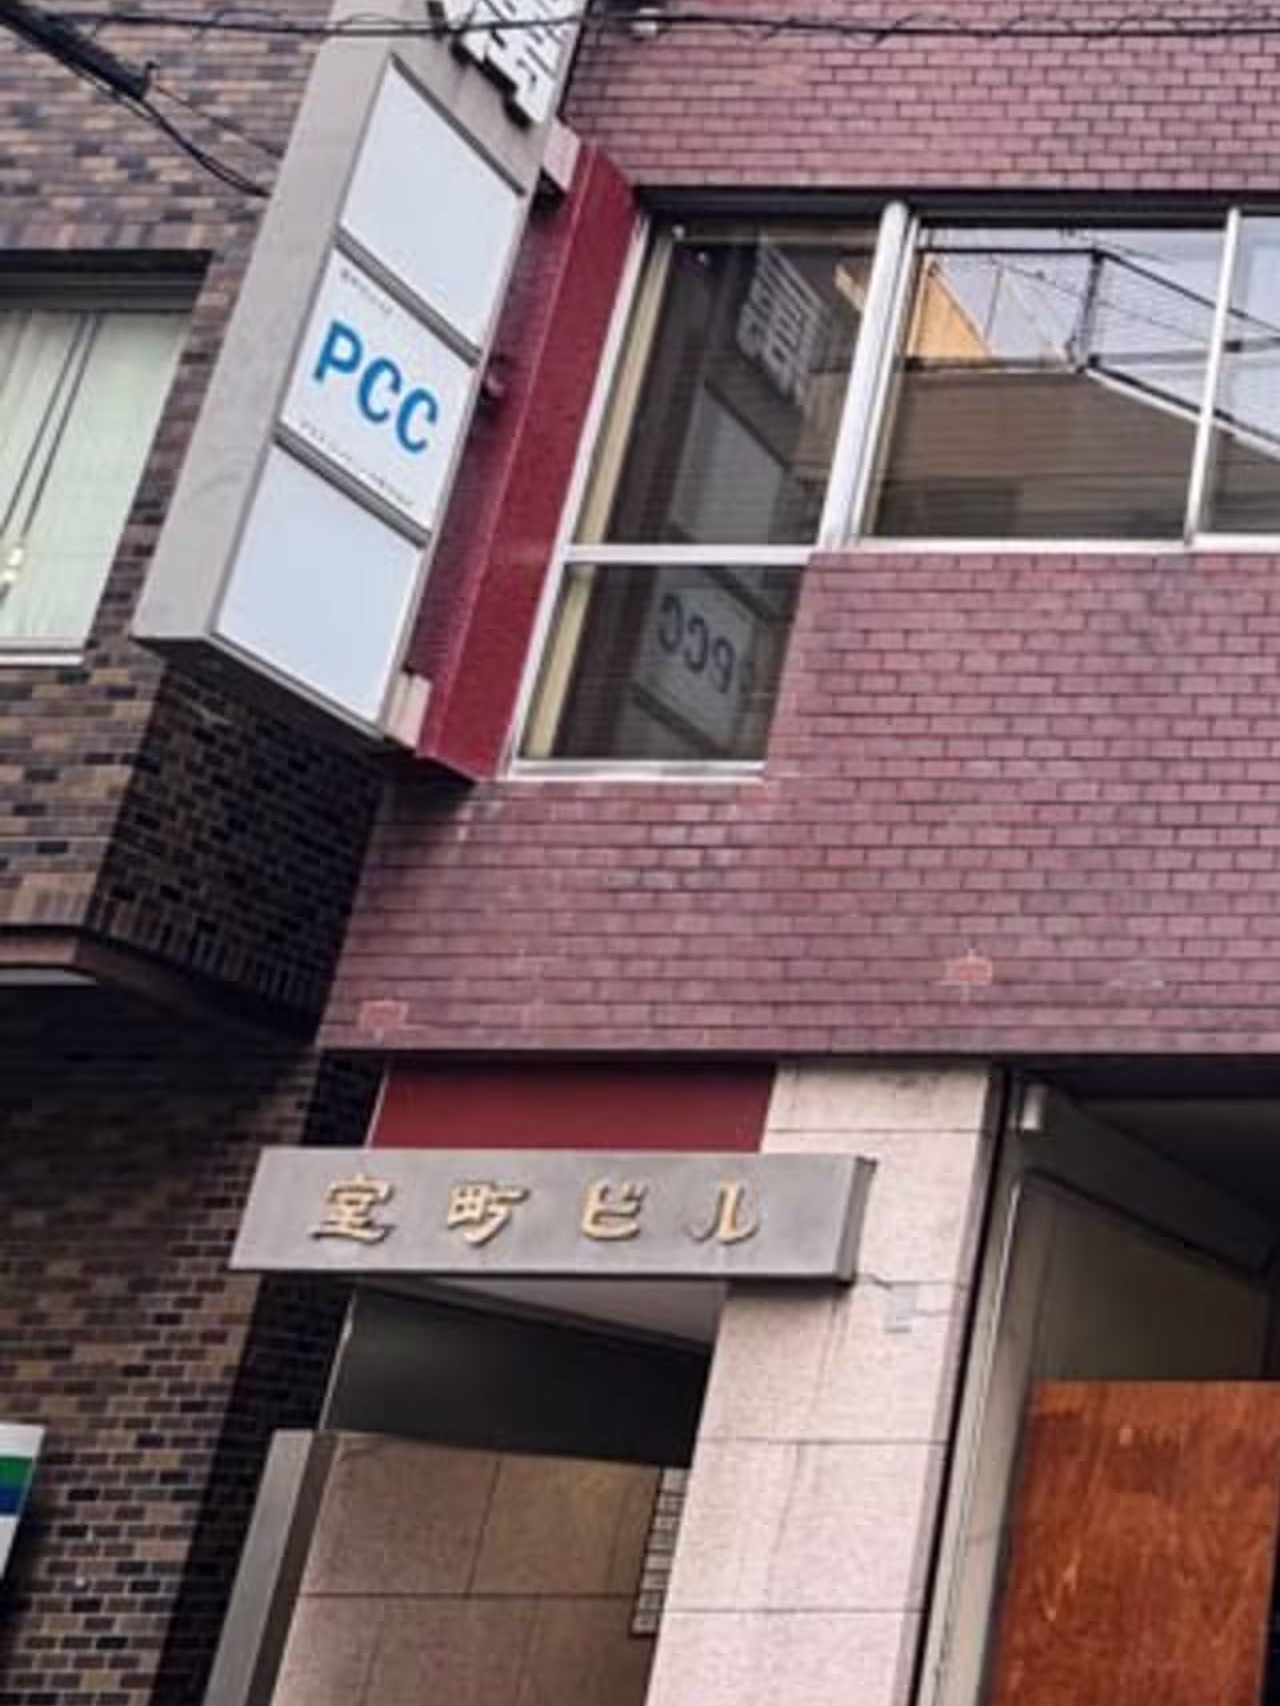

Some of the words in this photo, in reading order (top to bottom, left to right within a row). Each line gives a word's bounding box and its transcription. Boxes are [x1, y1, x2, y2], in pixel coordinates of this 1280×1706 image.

[314, 319, 439, 454] PCC
[309, 1174, 759, 1247] 室町ビル
